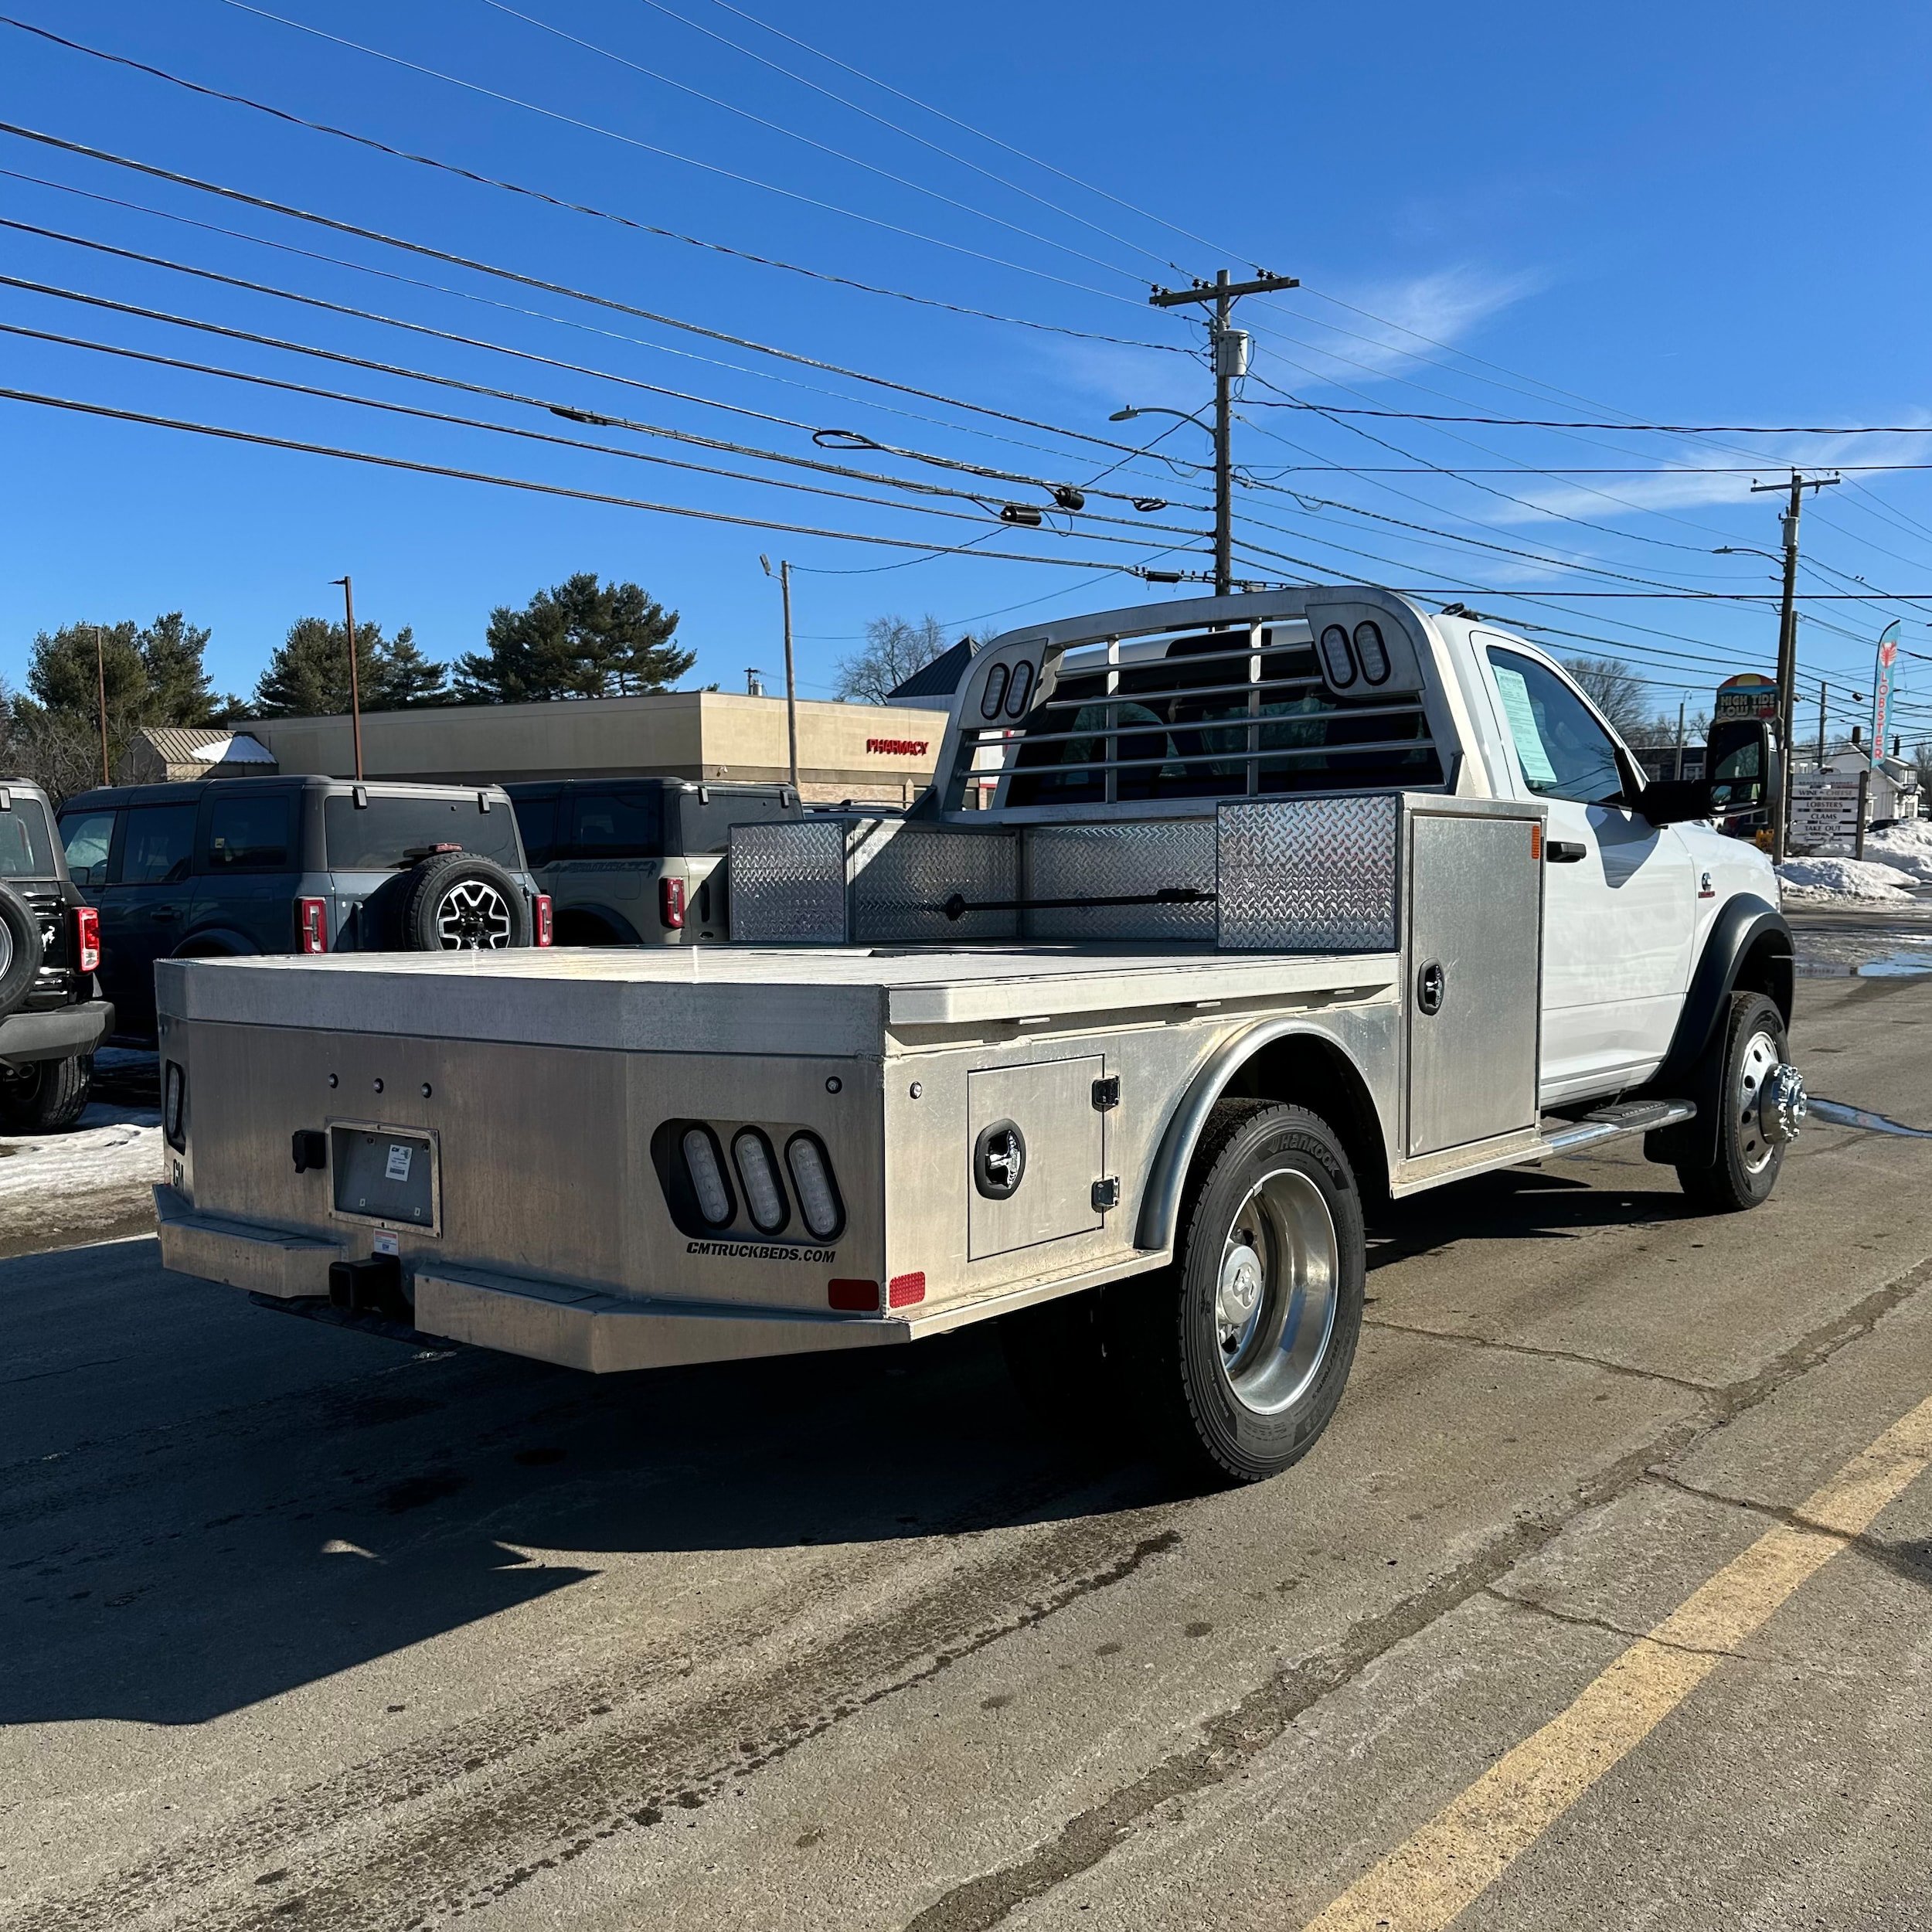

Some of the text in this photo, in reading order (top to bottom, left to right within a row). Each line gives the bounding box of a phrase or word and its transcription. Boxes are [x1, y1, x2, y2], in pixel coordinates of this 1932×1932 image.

[1721, 694, 1775, 706] HIGH TIDE
[1719, 706, 1748, 716] LOW
[1874, 672, 1888, 759] LOBSTER
[866, 739, 929, 756] PHARMACY
[686, 1242, 836, 1264] CMTRUCKBEDS.COM
